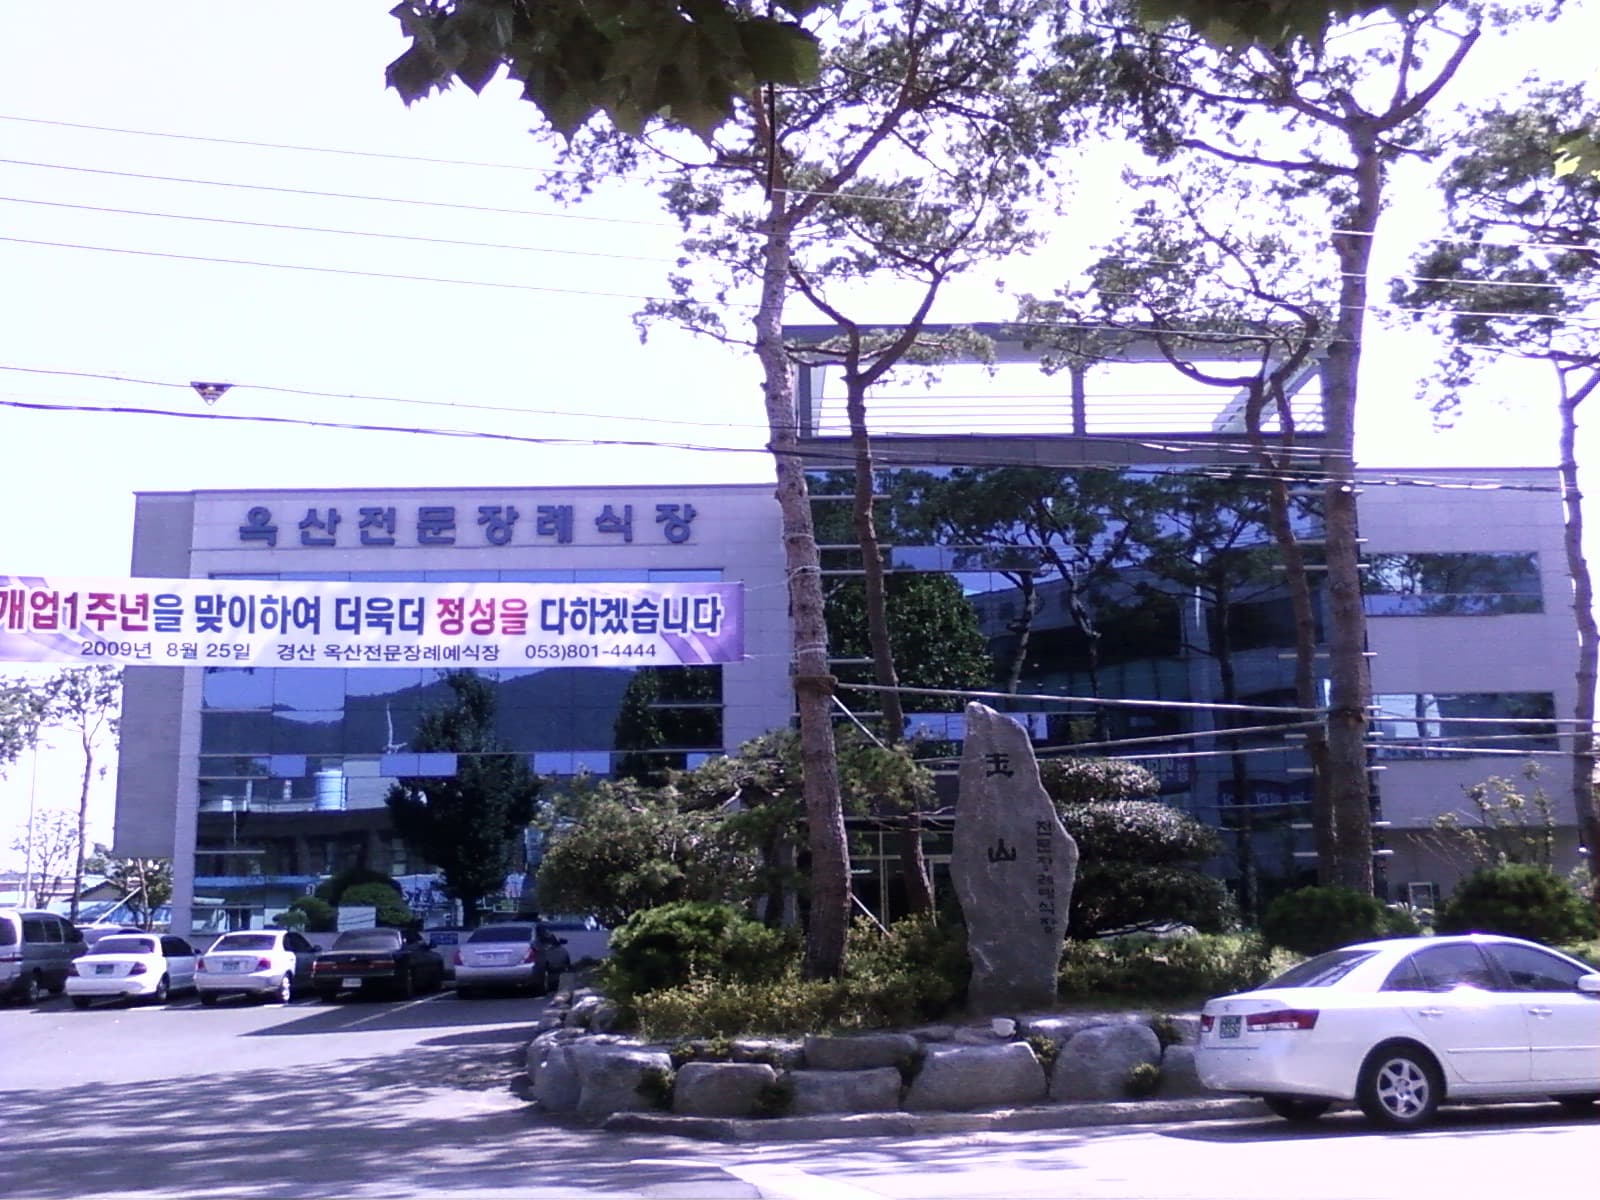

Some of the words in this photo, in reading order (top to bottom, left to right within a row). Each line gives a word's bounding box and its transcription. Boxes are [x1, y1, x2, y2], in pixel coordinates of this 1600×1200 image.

[239, 503, 697, 547] 옥산전문장례식장
[195, 593, 321, 635] 맞이하여
[334, 595, 425, 636] 더욱더
[437, 596, 528, 636] 정성을
[541, 595, 721, 636] 다하겠습니다
[80, 640, 152, 660] 2009년
[166, 642, 198, 660] 8월
[206, 642, 251, 660] 25일
[276, 643, 315, 662] 경산
[323, 643, 499, 663] 옥산전문장례예식장
[525, 643, 657, 660] 053)801-4444
